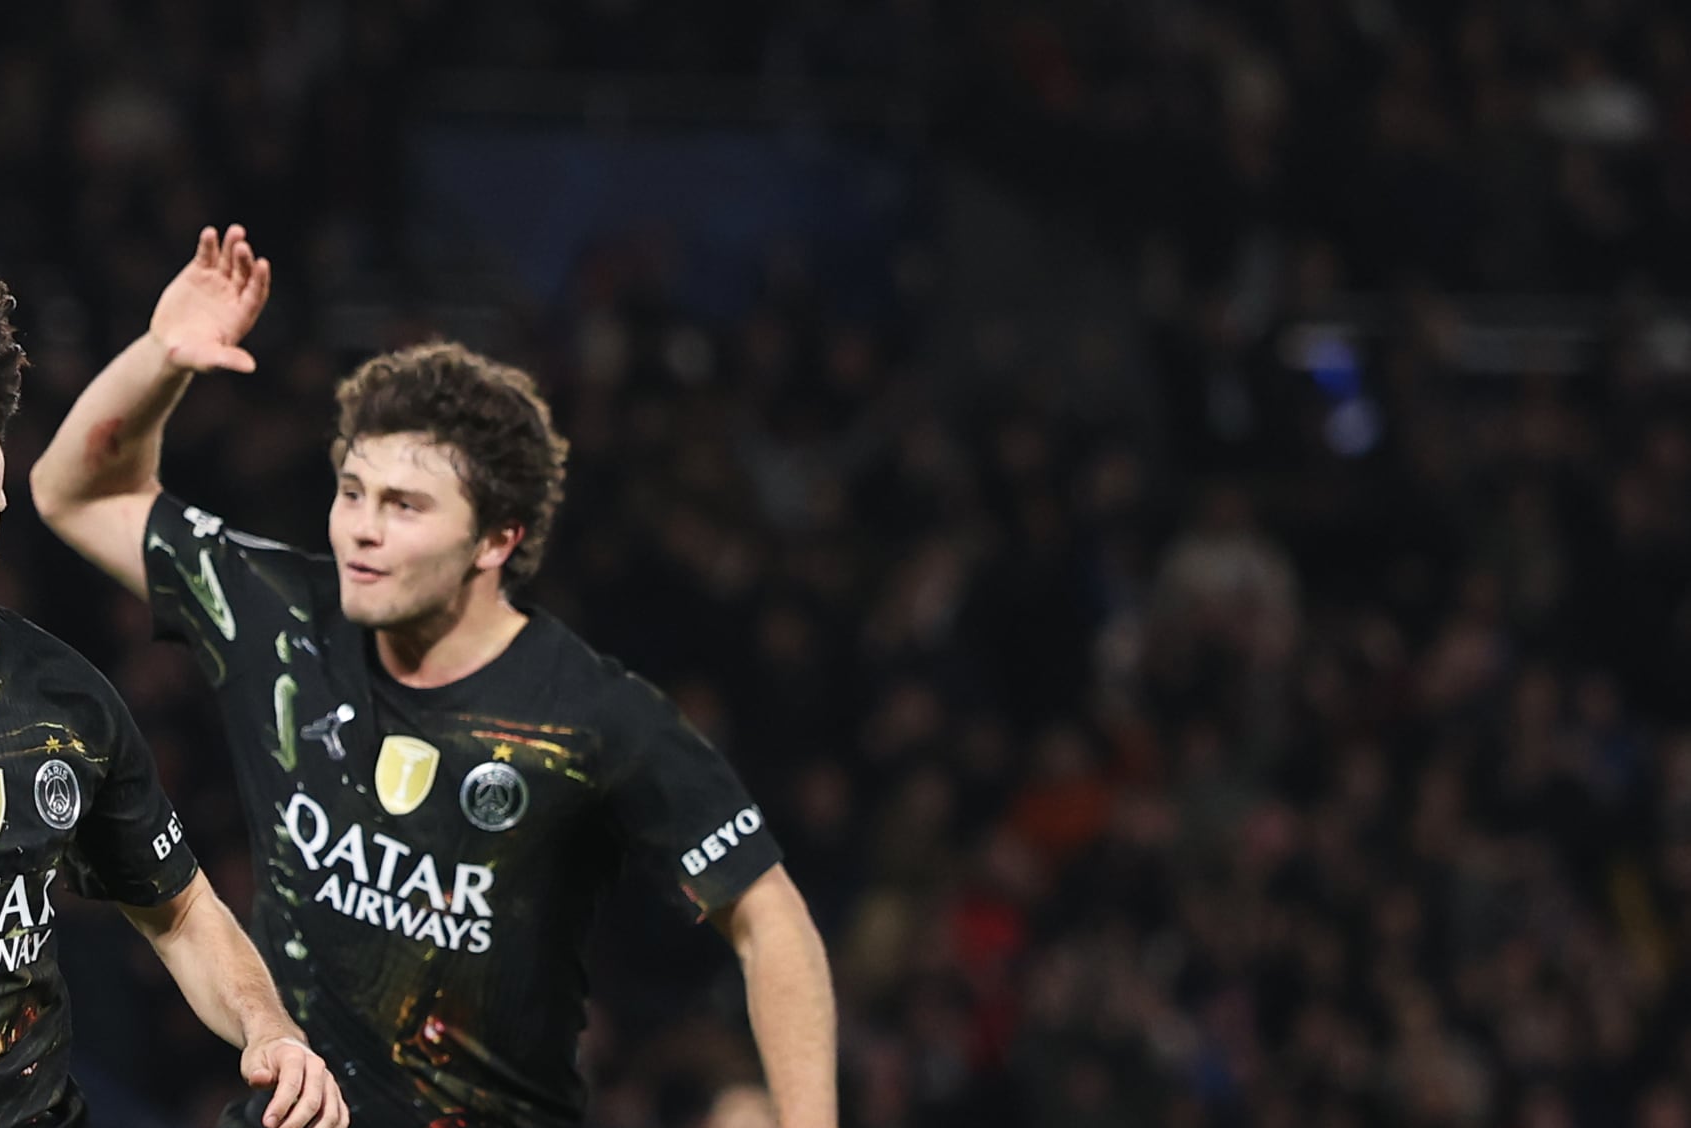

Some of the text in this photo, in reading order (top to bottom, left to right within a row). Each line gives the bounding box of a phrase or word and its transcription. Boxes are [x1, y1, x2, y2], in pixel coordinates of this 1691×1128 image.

[285, 793, 494, 918] QATAR
[681, 803, 761, 876] BEYO
[315, 873, 493, 953] AIRWAYS
